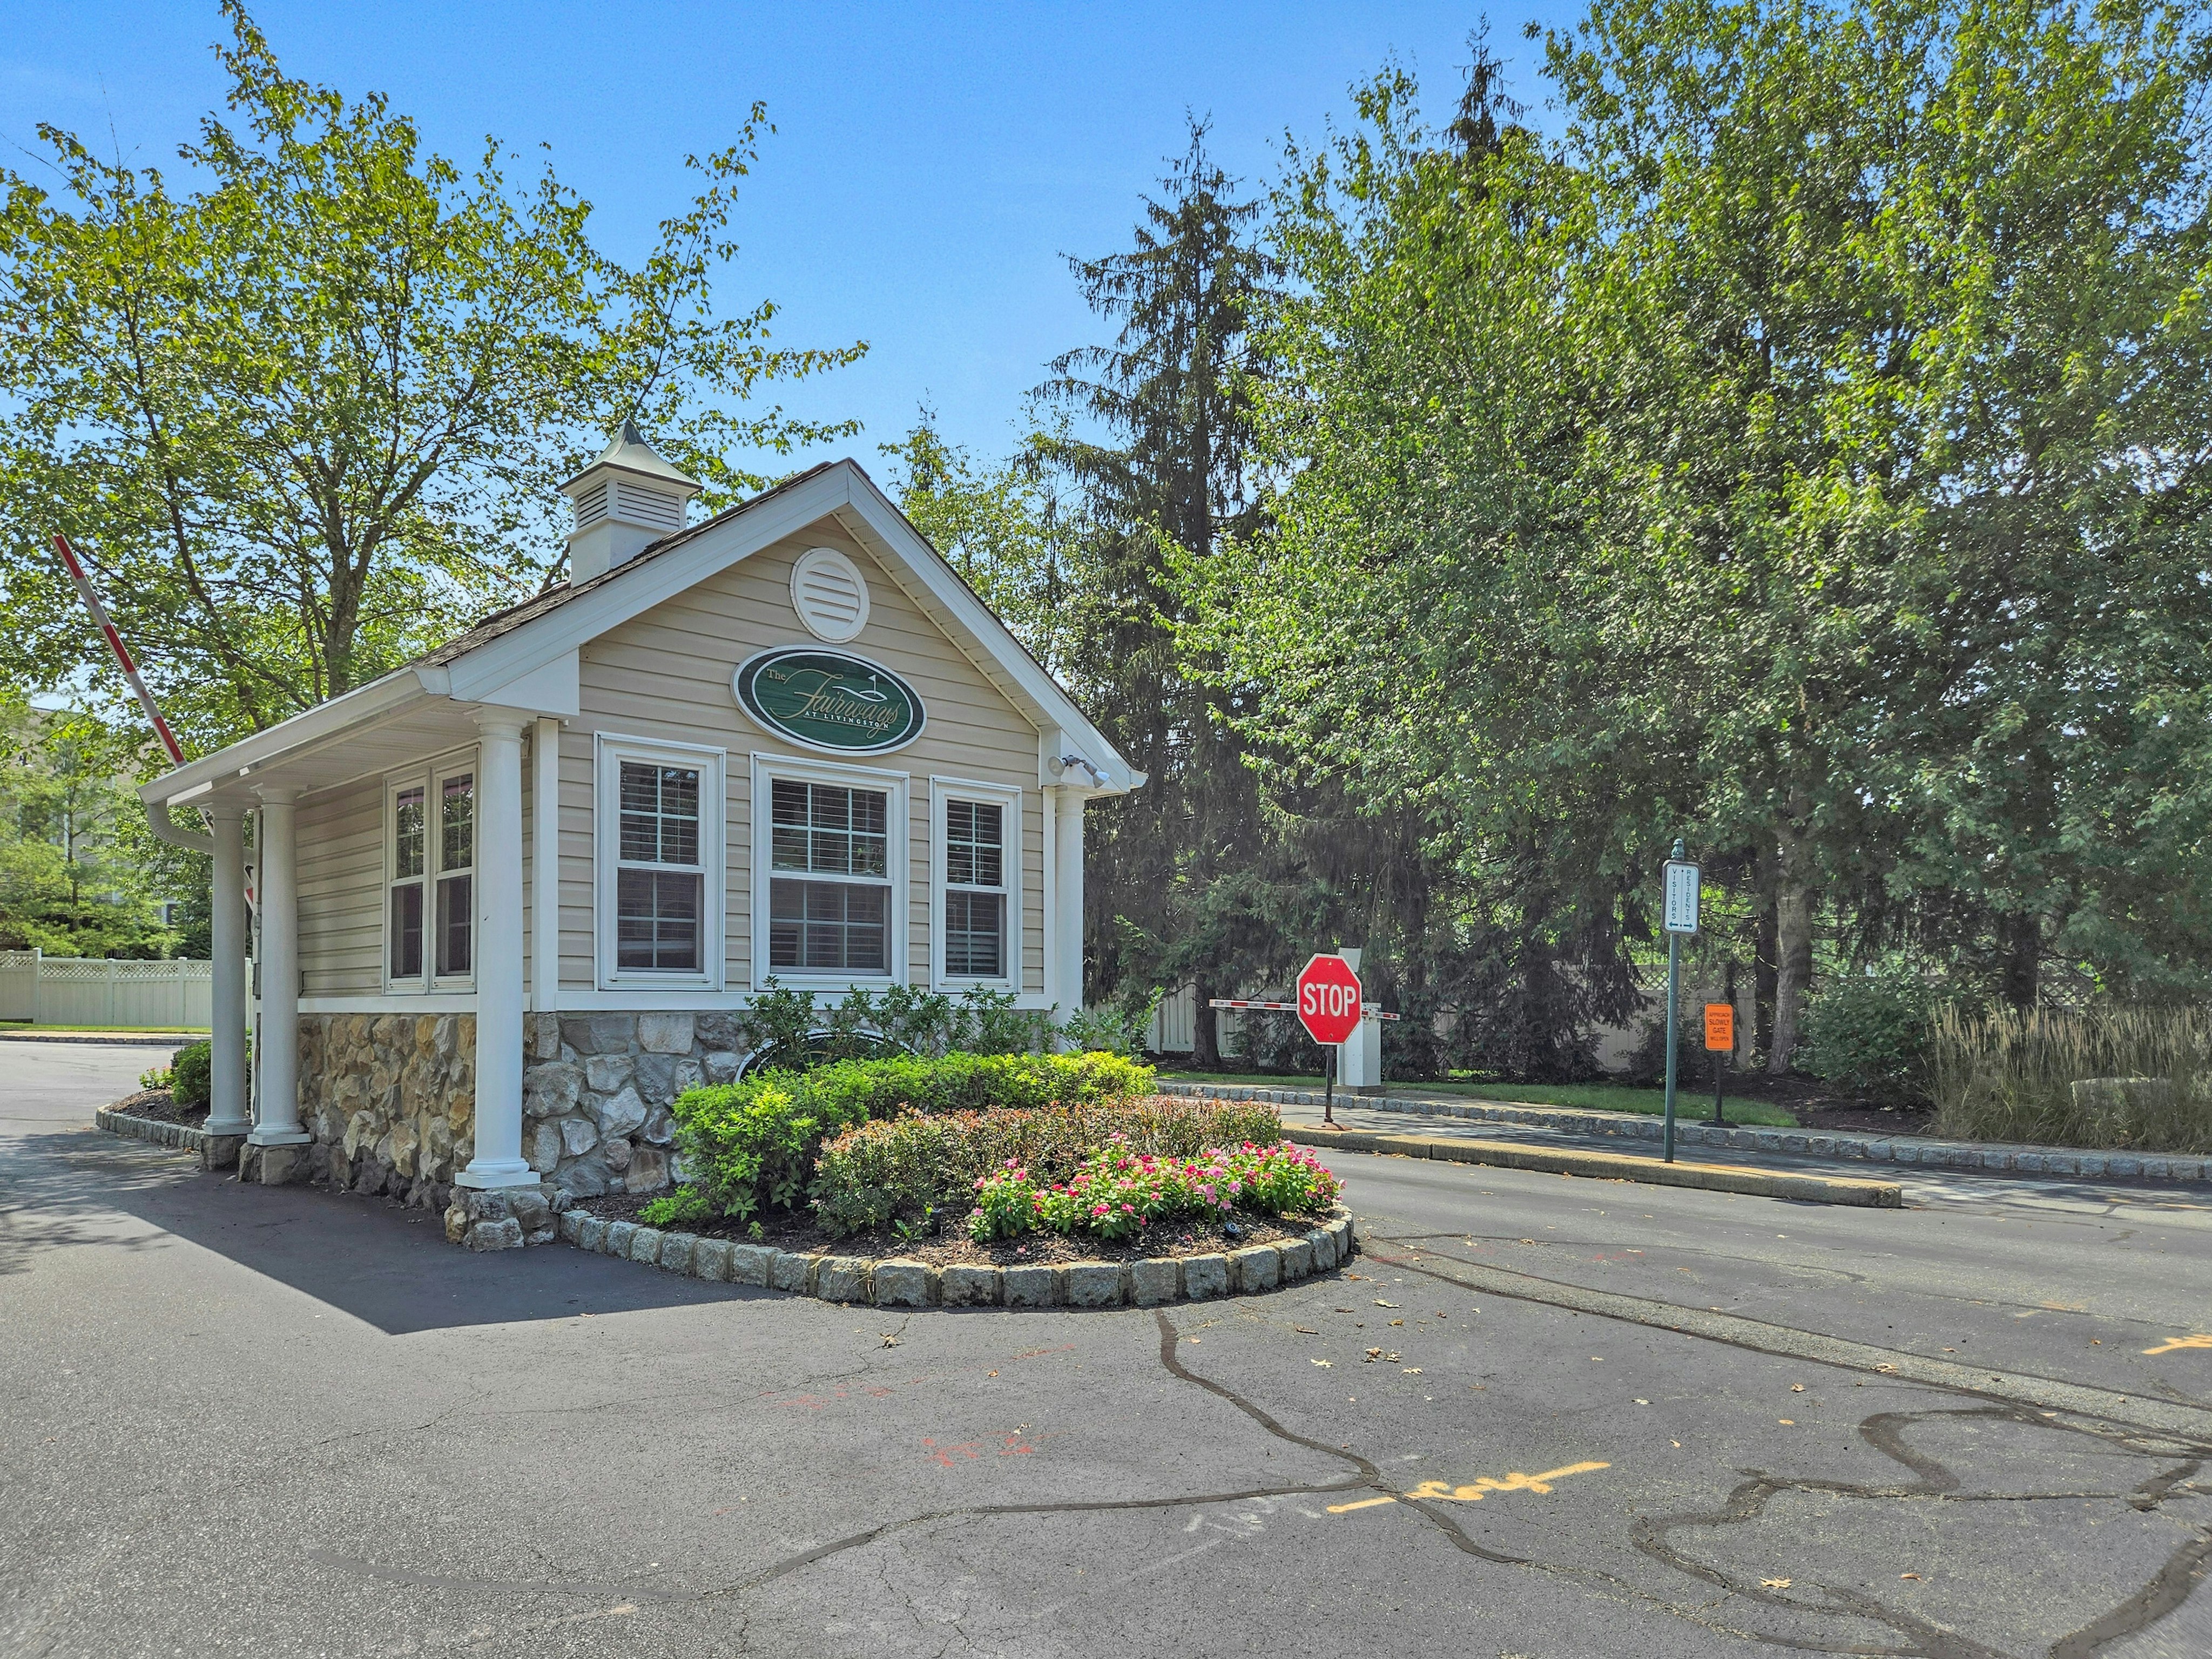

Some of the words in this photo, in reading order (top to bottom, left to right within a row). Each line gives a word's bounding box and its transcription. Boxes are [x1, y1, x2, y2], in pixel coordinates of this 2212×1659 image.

[766, 668, 786, 682] The
[770, 668, 901, 739] Fairways
[824, 713, 889, 729] LIVINGSTON
[1303, 982, 1357, 1017] STOP
